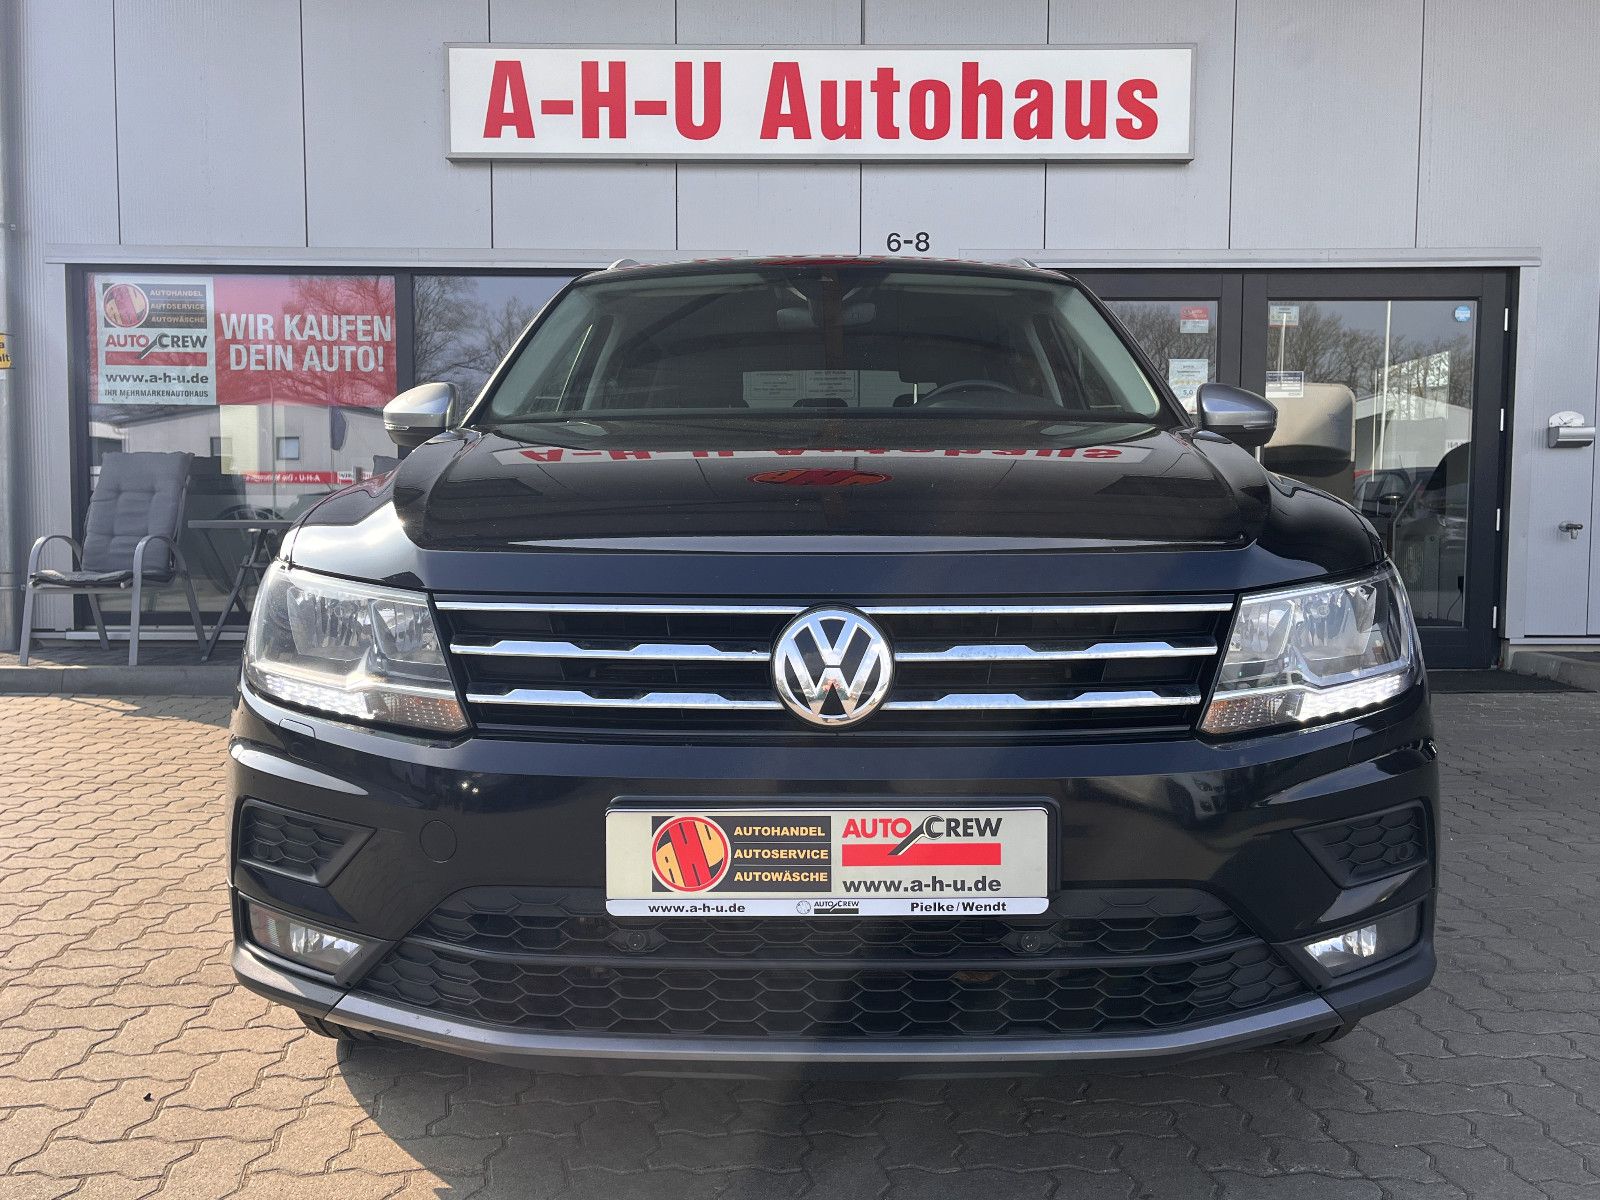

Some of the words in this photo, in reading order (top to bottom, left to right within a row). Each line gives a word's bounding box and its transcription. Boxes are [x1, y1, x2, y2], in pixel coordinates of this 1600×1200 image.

[483, 60, 722, 140] A-H-U
[760, 61, 1159, 141] Autohaus
[886, 233, 930, 253] 6-8
[150, 289, 203, 297] AUTOHANDEL
[150, 302, 205, 310] AUTOSERVICE
[151, 315, 205, 323] AUTOWÄSCHE
[220, 313, 274, 340] WIR
[284, 314, 392, 342] KAUFEN
[105, 334, 150, 348] AUTO
[157, 333, 207, 349] CREW
[229, 344, 293, 371] DEIN
[302, 345, 385, 372] AUTO!
[105, 372, 209, 384] www.a-h-u.de
[119, 389, 209, 398] MEHRMARKENAUTOHAUS
[734, 826, 826, 837] AUTOHANDEL
[842, 818, 912, 839] AUTO
[925, 815, 1003, 839] CREW
[734, 849, 829, 859] AUTOSERVICE
[734, 870, 828, 882] AUTOWÄSCHE
[842, 875, 1002, 893] www.a-h-u.de
[648, 903, 746, 914] www.a-h-u.de
